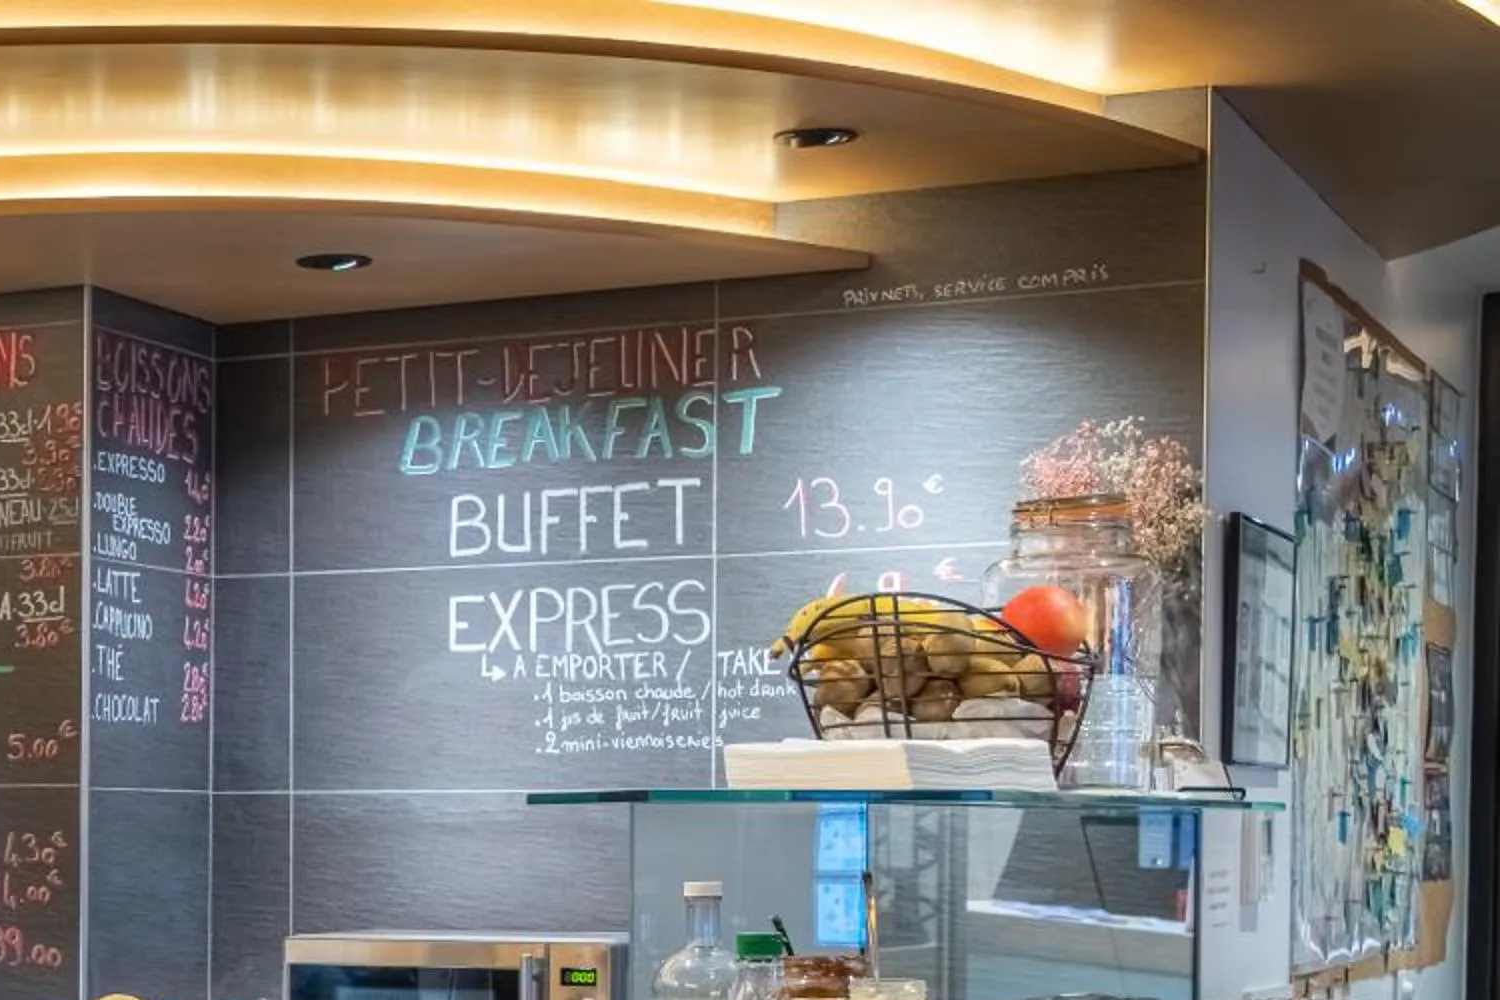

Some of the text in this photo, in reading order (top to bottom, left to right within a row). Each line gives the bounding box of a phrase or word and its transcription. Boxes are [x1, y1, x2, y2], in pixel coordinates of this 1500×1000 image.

[933, 274, 1008, 300] SERVICE
[399, 386, 784, 475] BREAKFAST
[97, 452, 166, 484] EXPRESSO
[449, 478, 701, 557] BUFFET
[96, 568, 142, 603] LATTE
[448, 580, 712, 653] EXPRESS
[95, 643, 125, 681] THÉ
[535, 652, 668, 681] EMPORTER
[558, 685, 628, 701] boisson
[635, 680, 697, 699] chaude
[716, 679, 743, 699] hot
[95, 693, 161, 724] CHOCOLAT
[718, 705, 762, 729] juice
